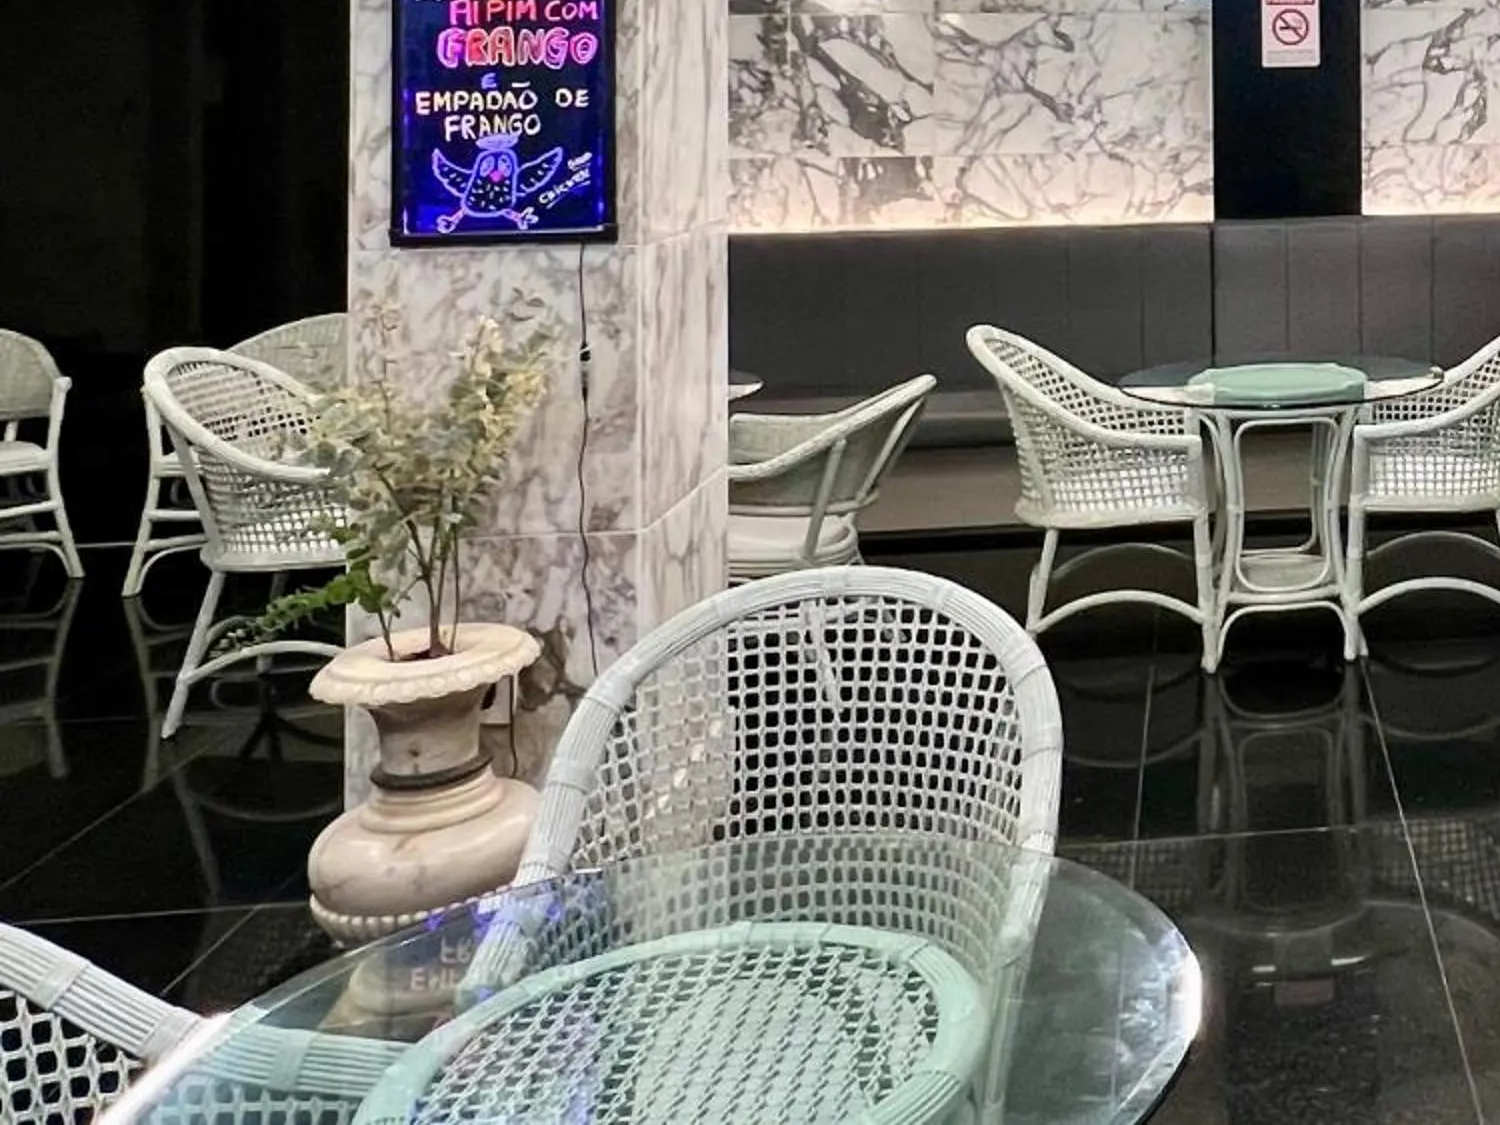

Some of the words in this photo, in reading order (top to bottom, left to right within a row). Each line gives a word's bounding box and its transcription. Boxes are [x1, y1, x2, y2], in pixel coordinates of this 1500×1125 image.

[544, 0, 599, 21] COM
[436, 26, 598, 69] FRANGO
[481, 72, 497, 89] E
[415, 81, 538, 115] EMPADÃO
[555, 87, 590, 108] DE
[444, 114, 541, 142] FRANGO
